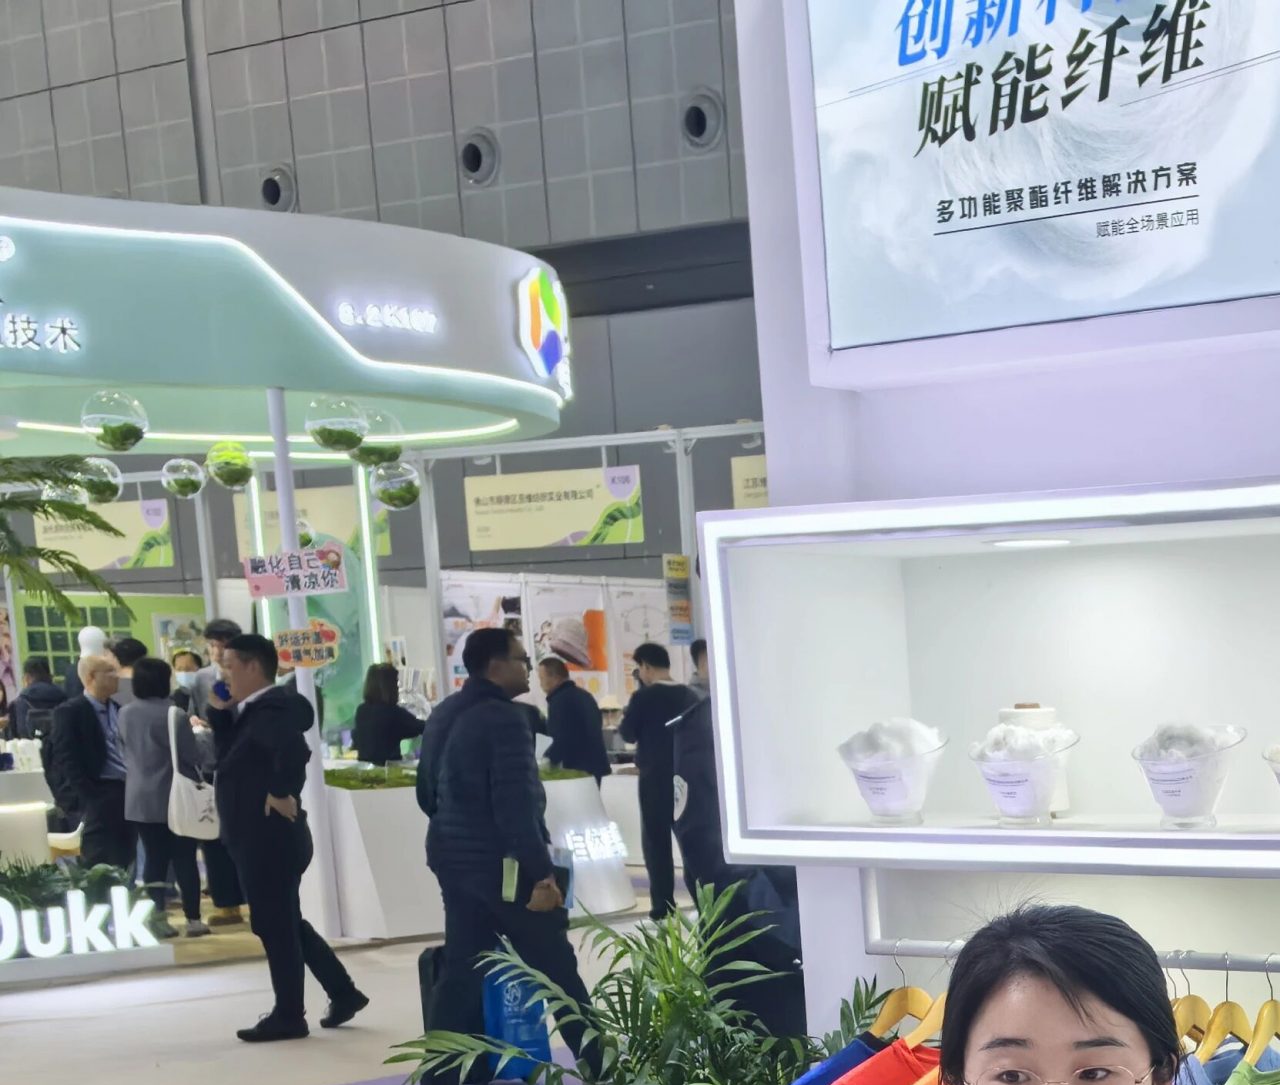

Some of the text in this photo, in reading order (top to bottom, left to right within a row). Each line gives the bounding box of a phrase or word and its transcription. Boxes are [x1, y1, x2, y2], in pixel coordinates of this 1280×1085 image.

[913, 0, 1210, 158] 赋能纤维
[937, 161, 1197, 224] 多功能聚酯纤维解决方案
[1096, 208, 1199, 238] 赋能全场景应用
[0, 312, 81, 353] 技术
